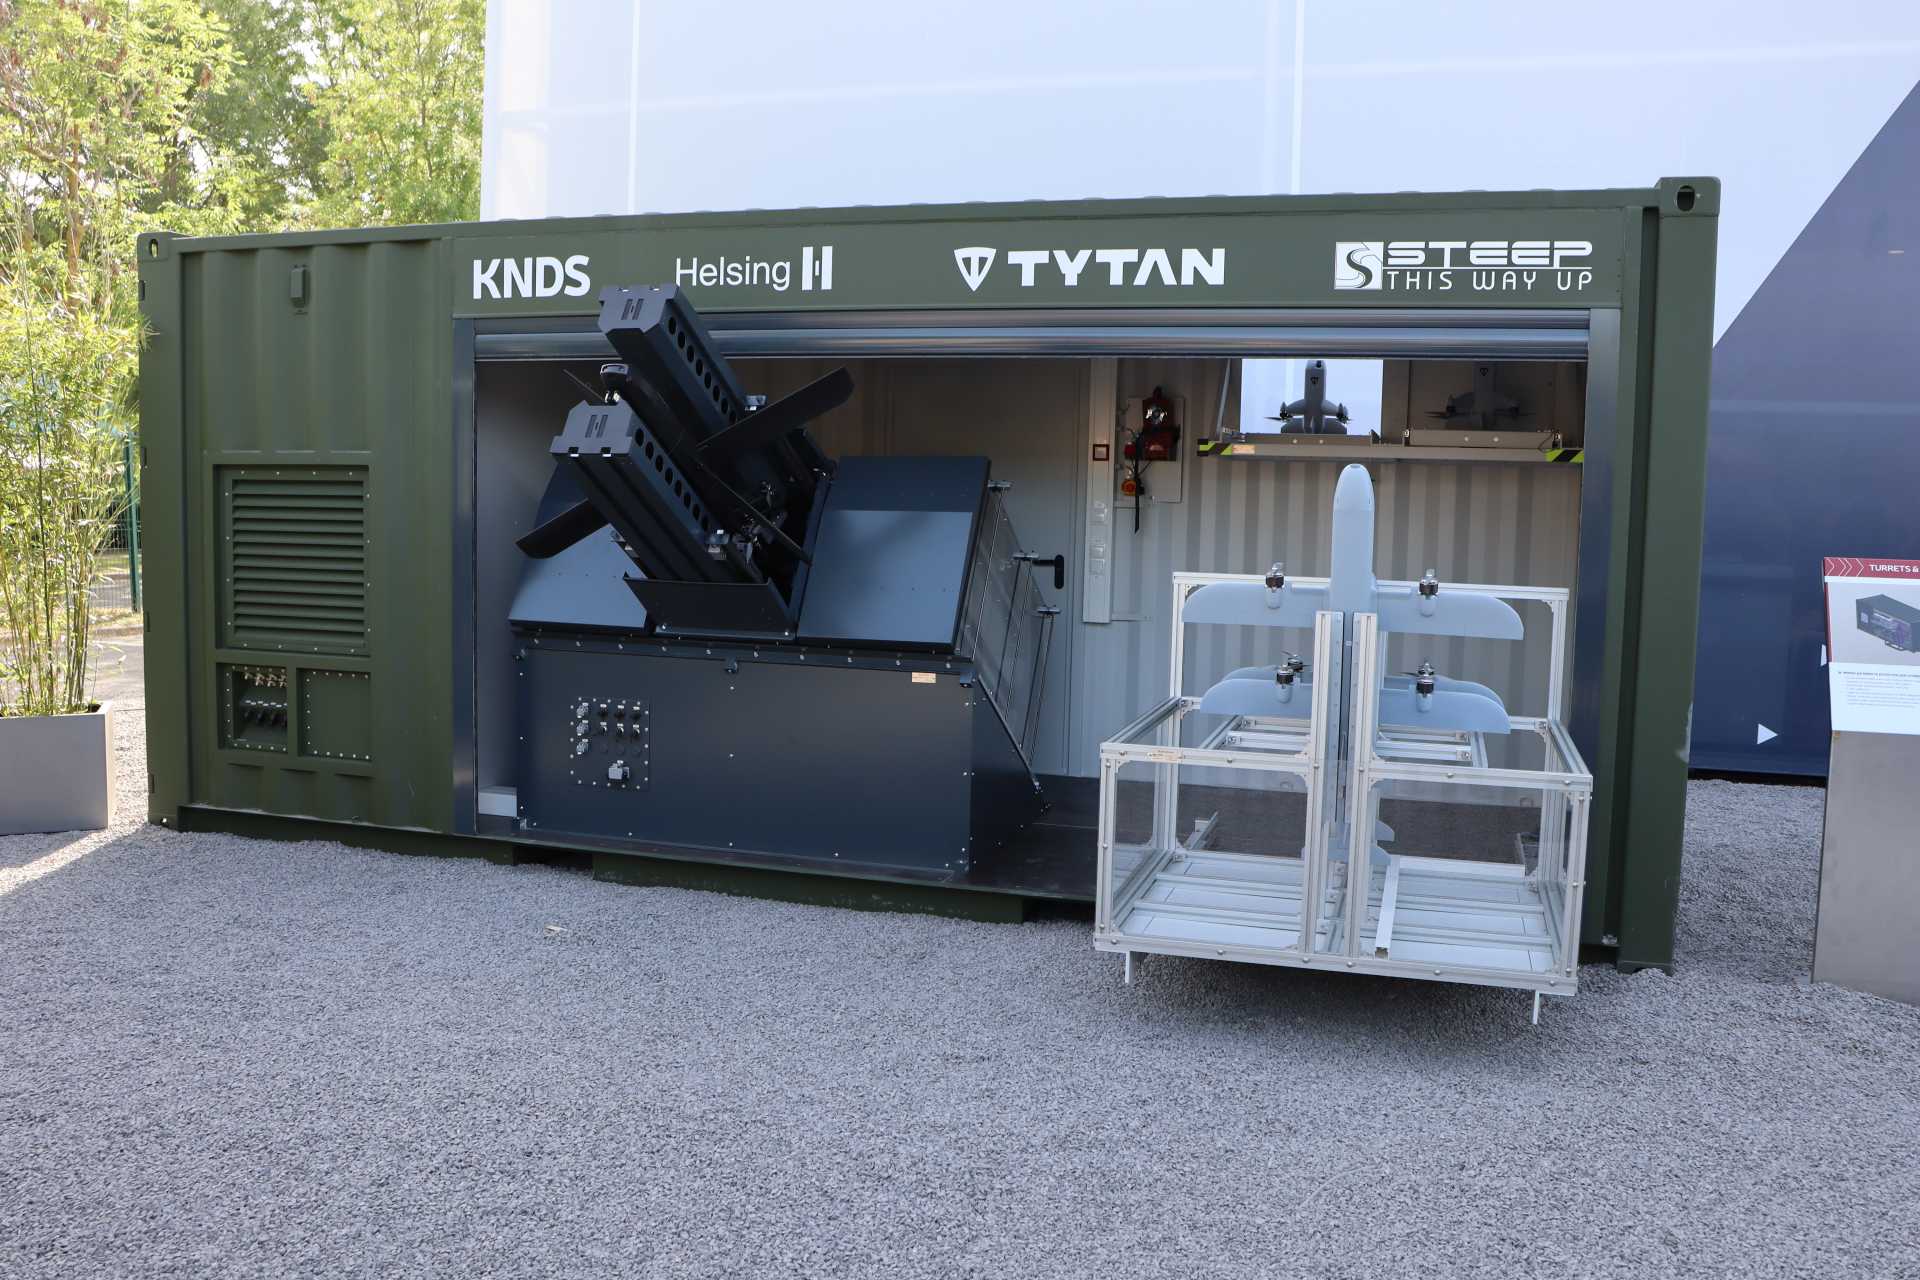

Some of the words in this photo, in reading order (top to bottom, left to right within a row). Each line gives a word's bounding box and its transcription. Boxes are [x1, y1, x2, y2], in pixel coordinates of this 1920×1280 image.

[1007, 247, 1226, 287] TYTAN
[1386, 240, 1593, 269] STEEP
[472, 254, 591, 300] KNDS
[675, 255, 791, 292] Helsing
[1386, 270, 1453, 291] THIS
[1472, 270, 1537, 291] WAY
[1557, 270, 1593, 291] UP
[1868, 564, 1911, 573] TURRETS
